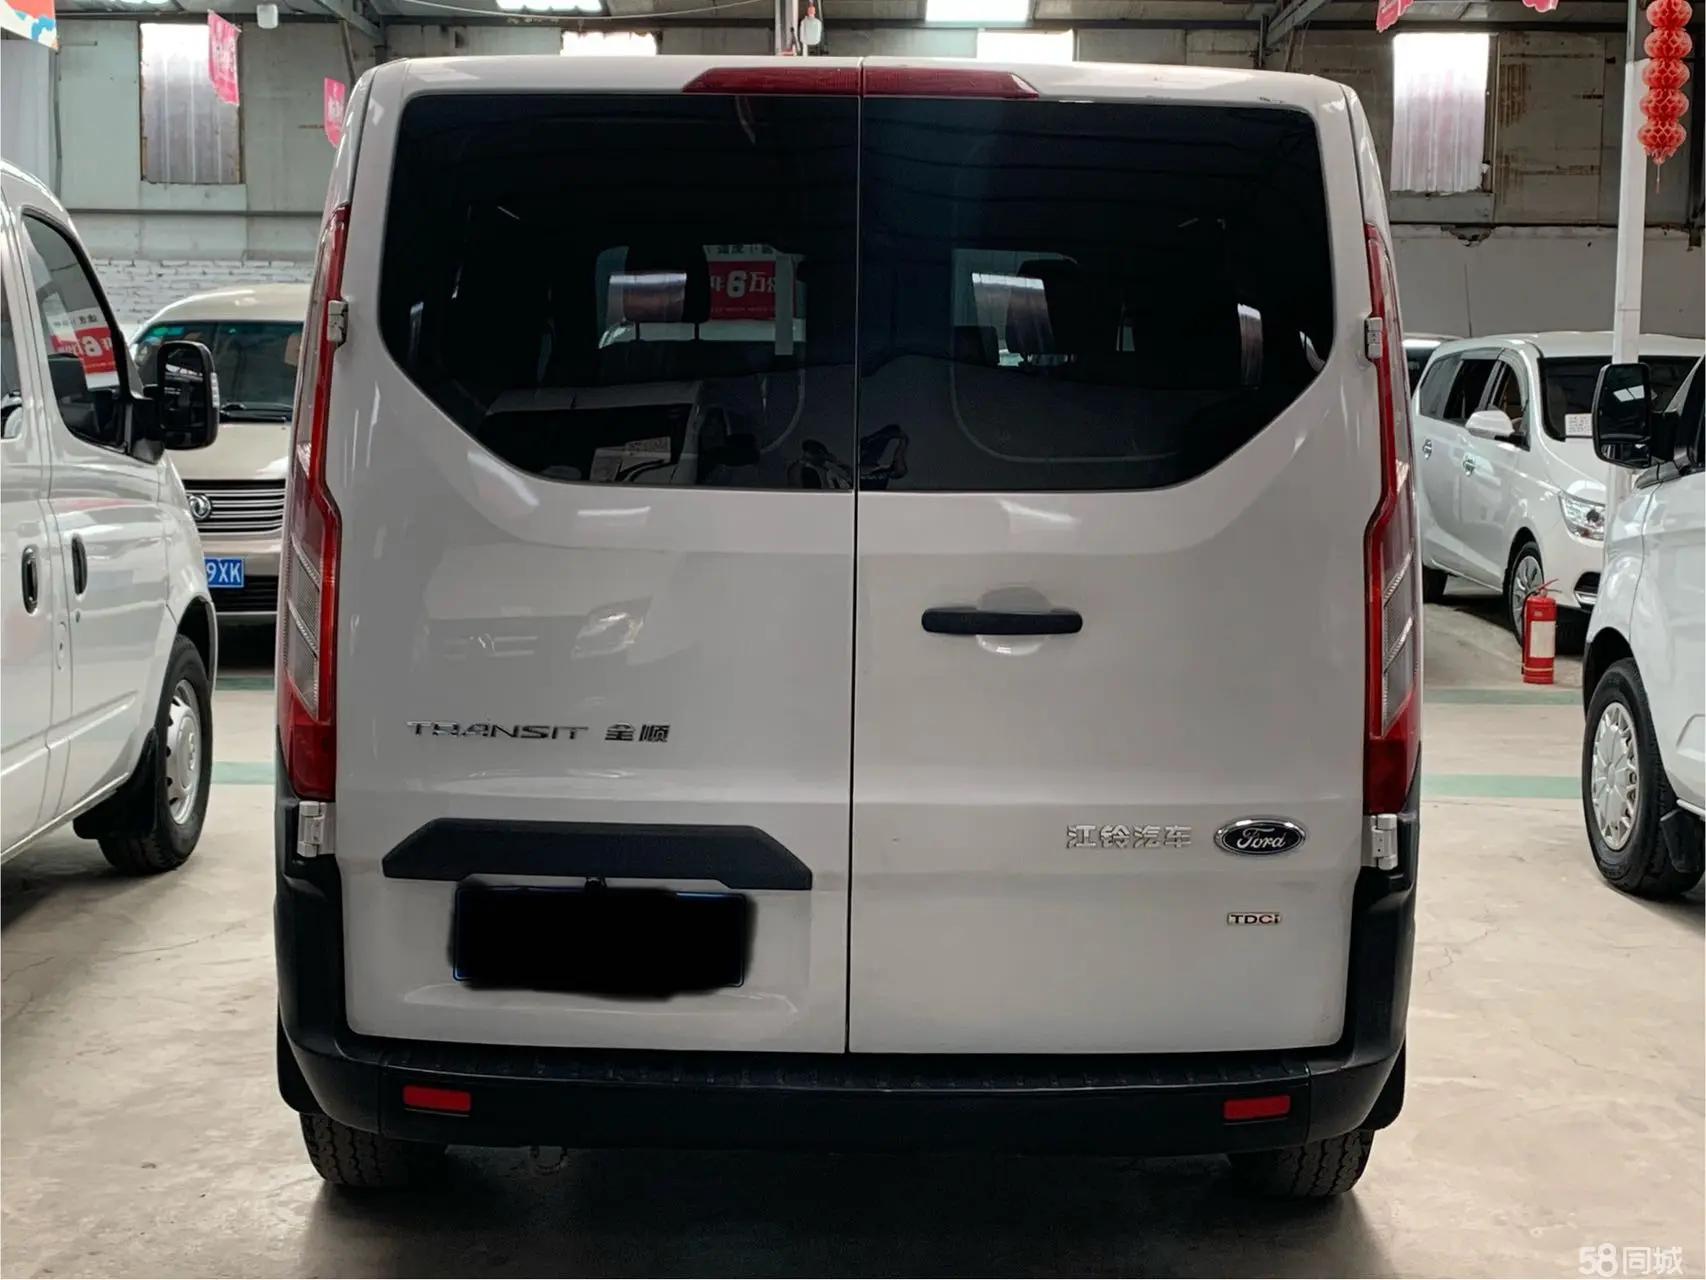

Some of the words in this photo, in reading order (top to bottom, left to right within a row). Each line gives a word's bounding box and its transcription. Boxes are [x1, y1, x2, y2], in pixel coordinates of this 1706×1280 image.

[206, 562, 241, 583] 9XK
[406, 720, 589, 740] TRANSIT
[604, 721, 670, 742] 全顺
[1066, 824, 1192, 849] 江铃汽车
[1236, 827, 1286, 849] Ford
[1229, 913, 1280, 925] TDCi
